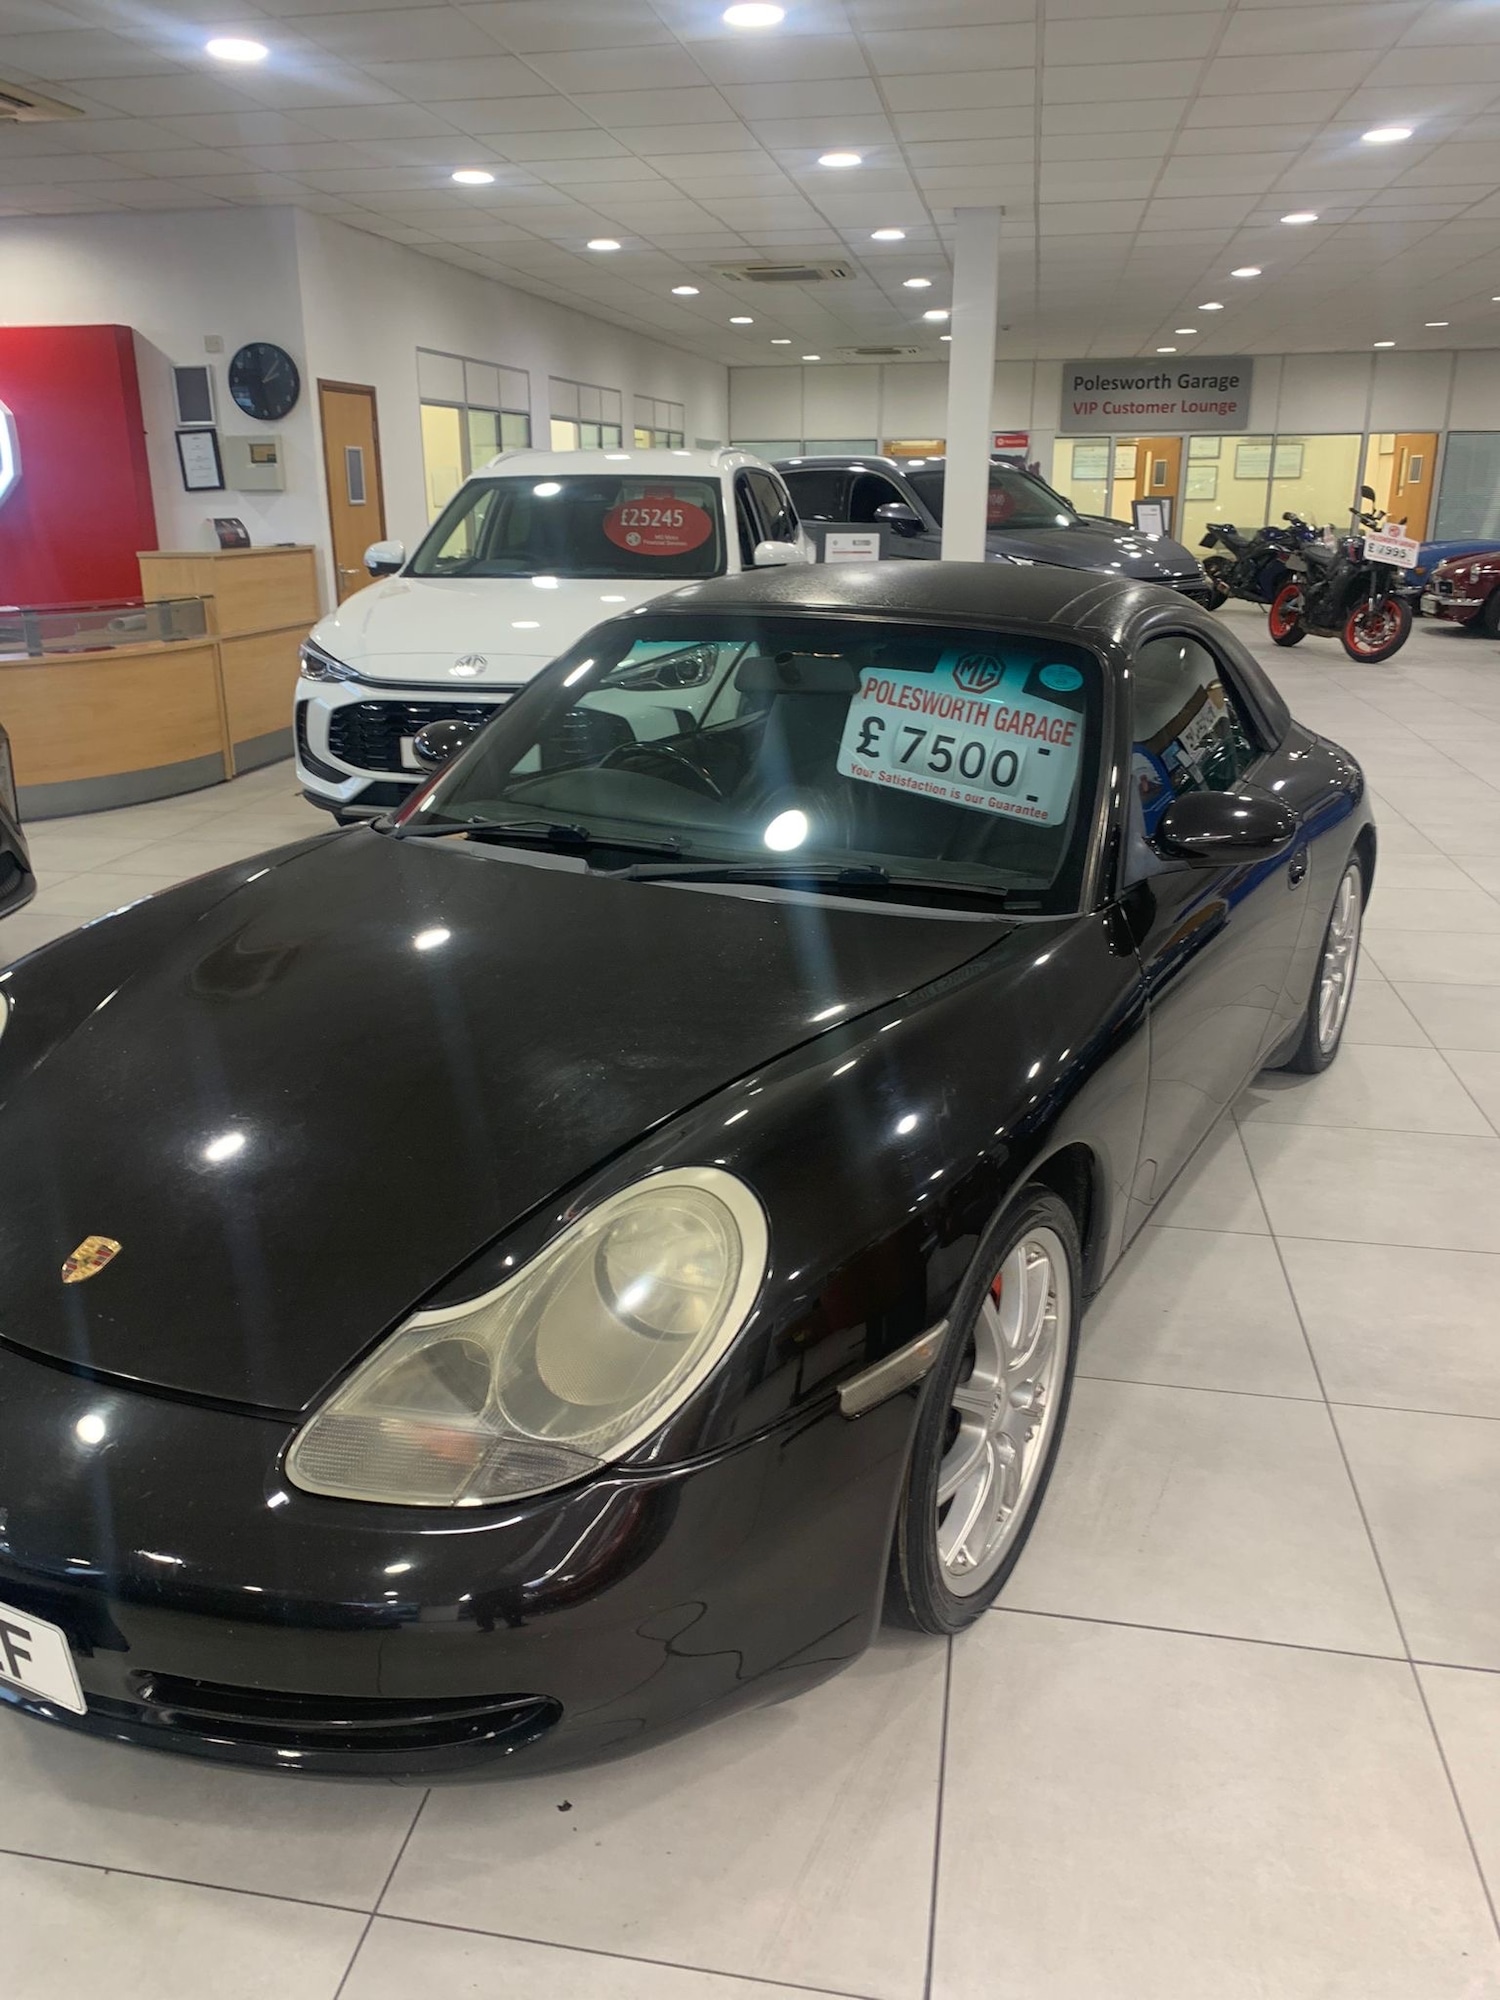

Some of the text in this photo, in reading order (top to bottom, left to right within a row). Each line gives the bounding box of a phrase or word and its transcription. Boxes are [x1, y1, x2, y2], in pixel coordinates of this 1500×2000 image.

[1073, 373, 1241, 391] Polesworth Garage
[1073, 400, 1238, 416] VIP Customer Lounge
[620, 508, 684, 527] £25245
[862, 677, 1077, 746] POLESWORTH GARAGE
[856, 716, 1019, 788] £ 7500
[851, 763, 1048, 820] Your Satisfaction is our Guarantee
[0, 1619, 32, 1680] F
